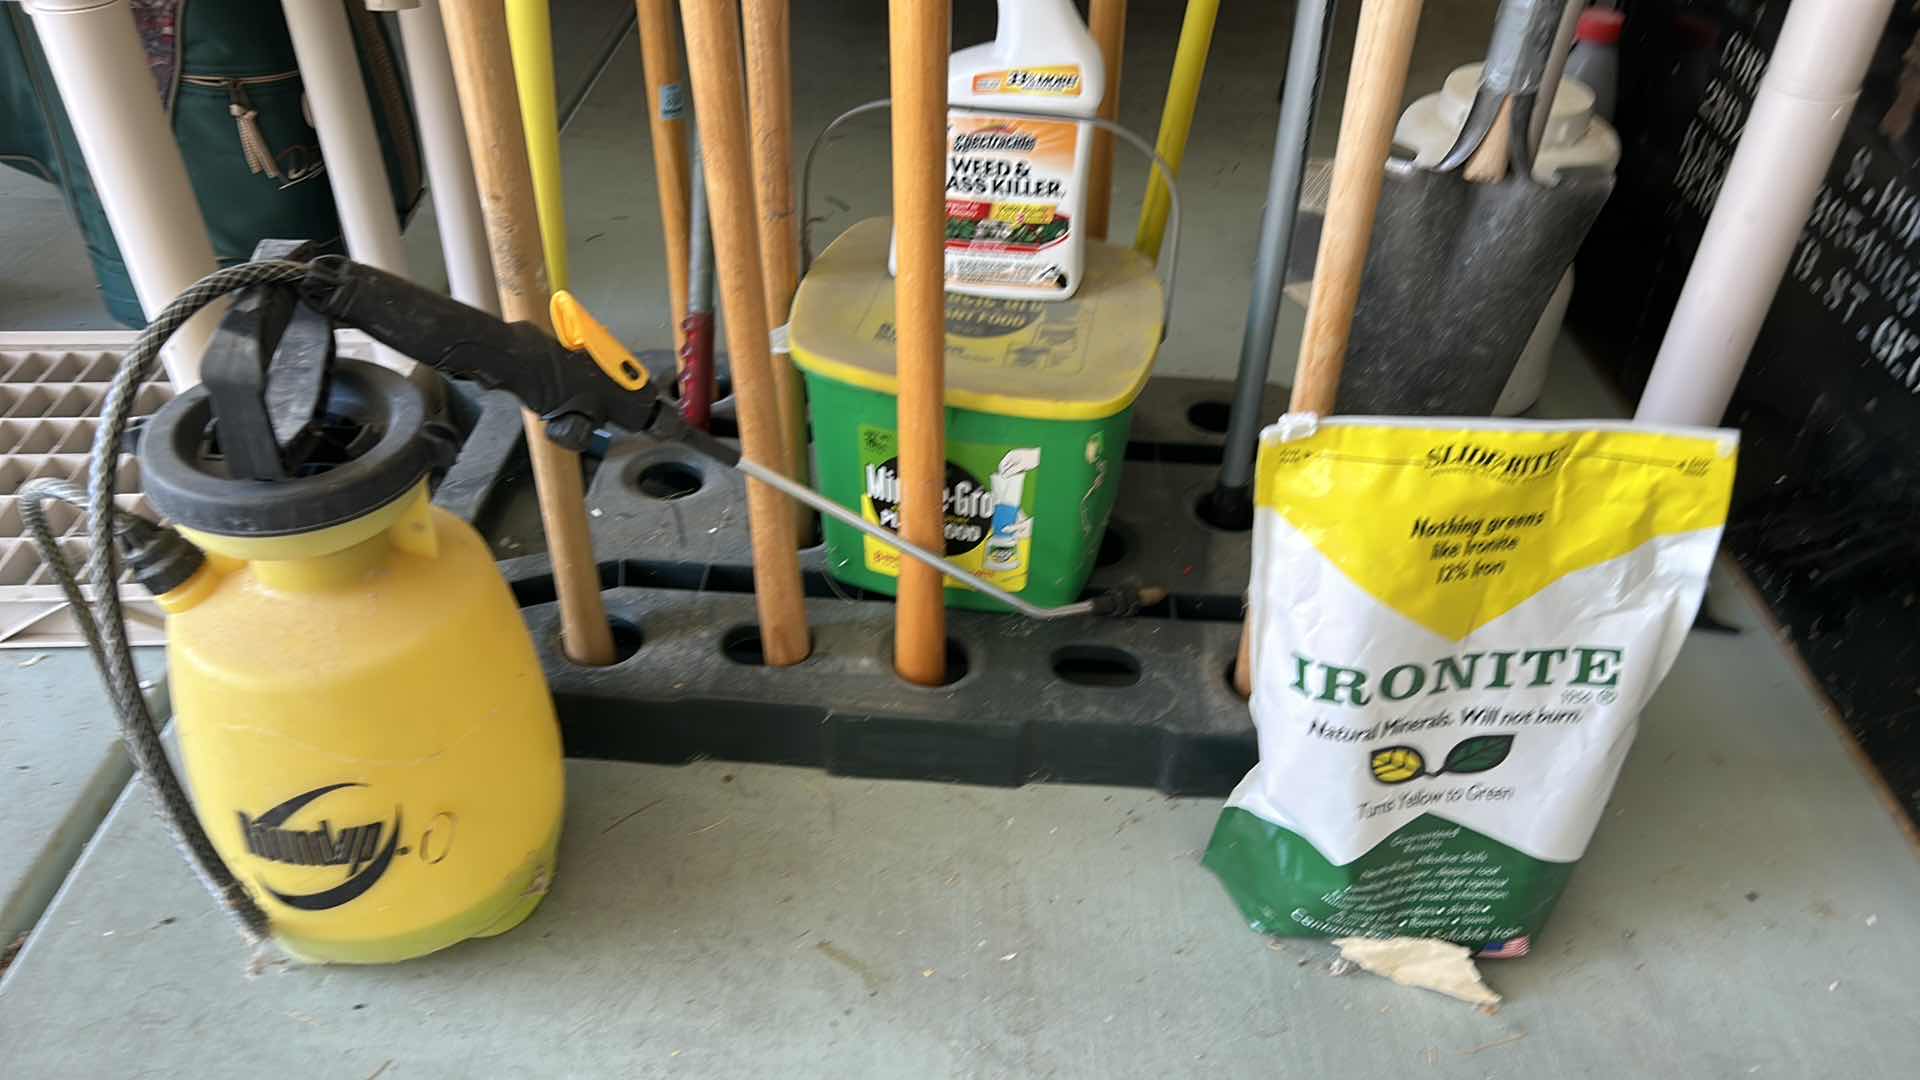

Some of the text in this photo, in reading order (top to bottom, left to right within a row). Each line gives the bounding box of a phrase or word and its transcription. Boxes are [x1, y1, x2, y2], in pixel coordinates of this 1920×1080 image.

[952, 157, 1031, 177] WEED &
[945, 175, 988, 194] ASS
[1410, 510, 1547, 538] Nothing greens
[1430, 535, 1520, 559] like Ironite
[1436, 558, 1506, 584] 12% Iron
[1289, 647, 1624, 706] IRONITE
[1306, 719, 1378, 743] Natural
[1460, 705, 1499, 727] Will
[1501, 708, 1532, 725] not
[1358, 783, 1515, 820] Turns Yellow to Green
